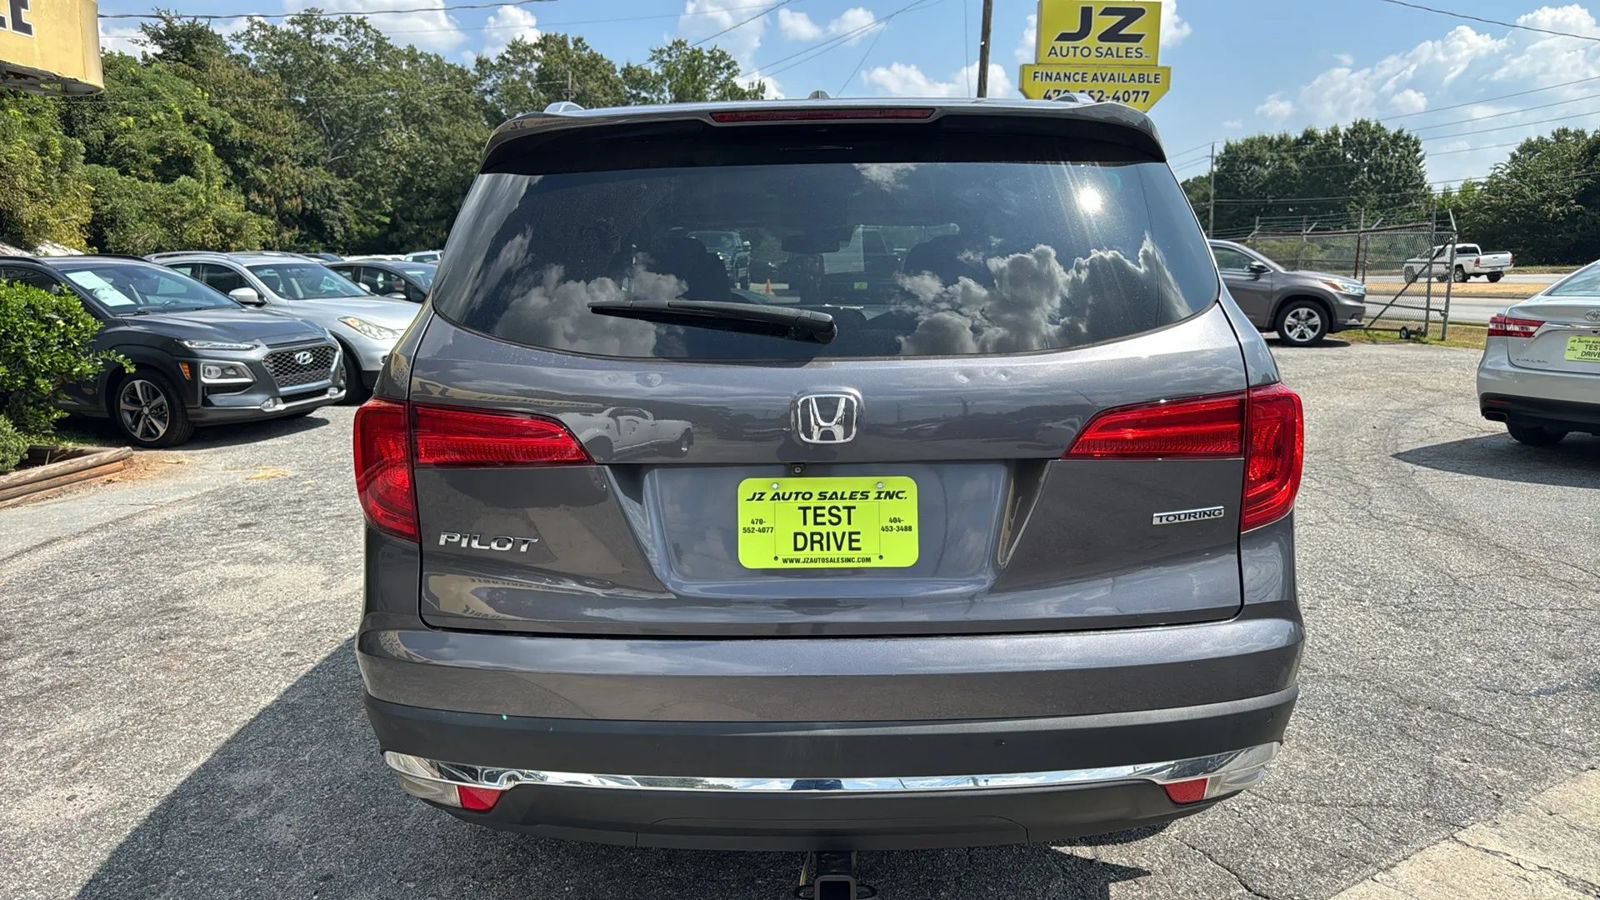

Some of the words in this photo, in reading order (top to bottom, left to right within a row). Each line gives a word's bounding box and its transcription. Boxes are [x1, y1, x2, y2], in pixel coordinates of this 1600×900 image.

[1054, 6, 1146, 43] JZ
[1047, 46, 1091, 58] AUTO
[1095, 47, 1144, 59] SALES
[1033, 71, 1088, 83] FINANCE
[1091, 72, 1161, 84] AVAILABLE
[746, 492, 766, 501] JZ
[769, 491, 813, 501] AUTO
[817, 490, 871, 501] SALES
[874, 490, 908, 500] INC.
[798, 505, 857, 526] TEST
[1154, 508, 1223, 523] TOURING
[742, 526, 774, 534] 552-4077
[438, 531, 539, 552] PILOT
[793, 531, 862, 552] DRIVE
[782, 556, 871, 564] WWW.JZAUTOSALESINC.COM
